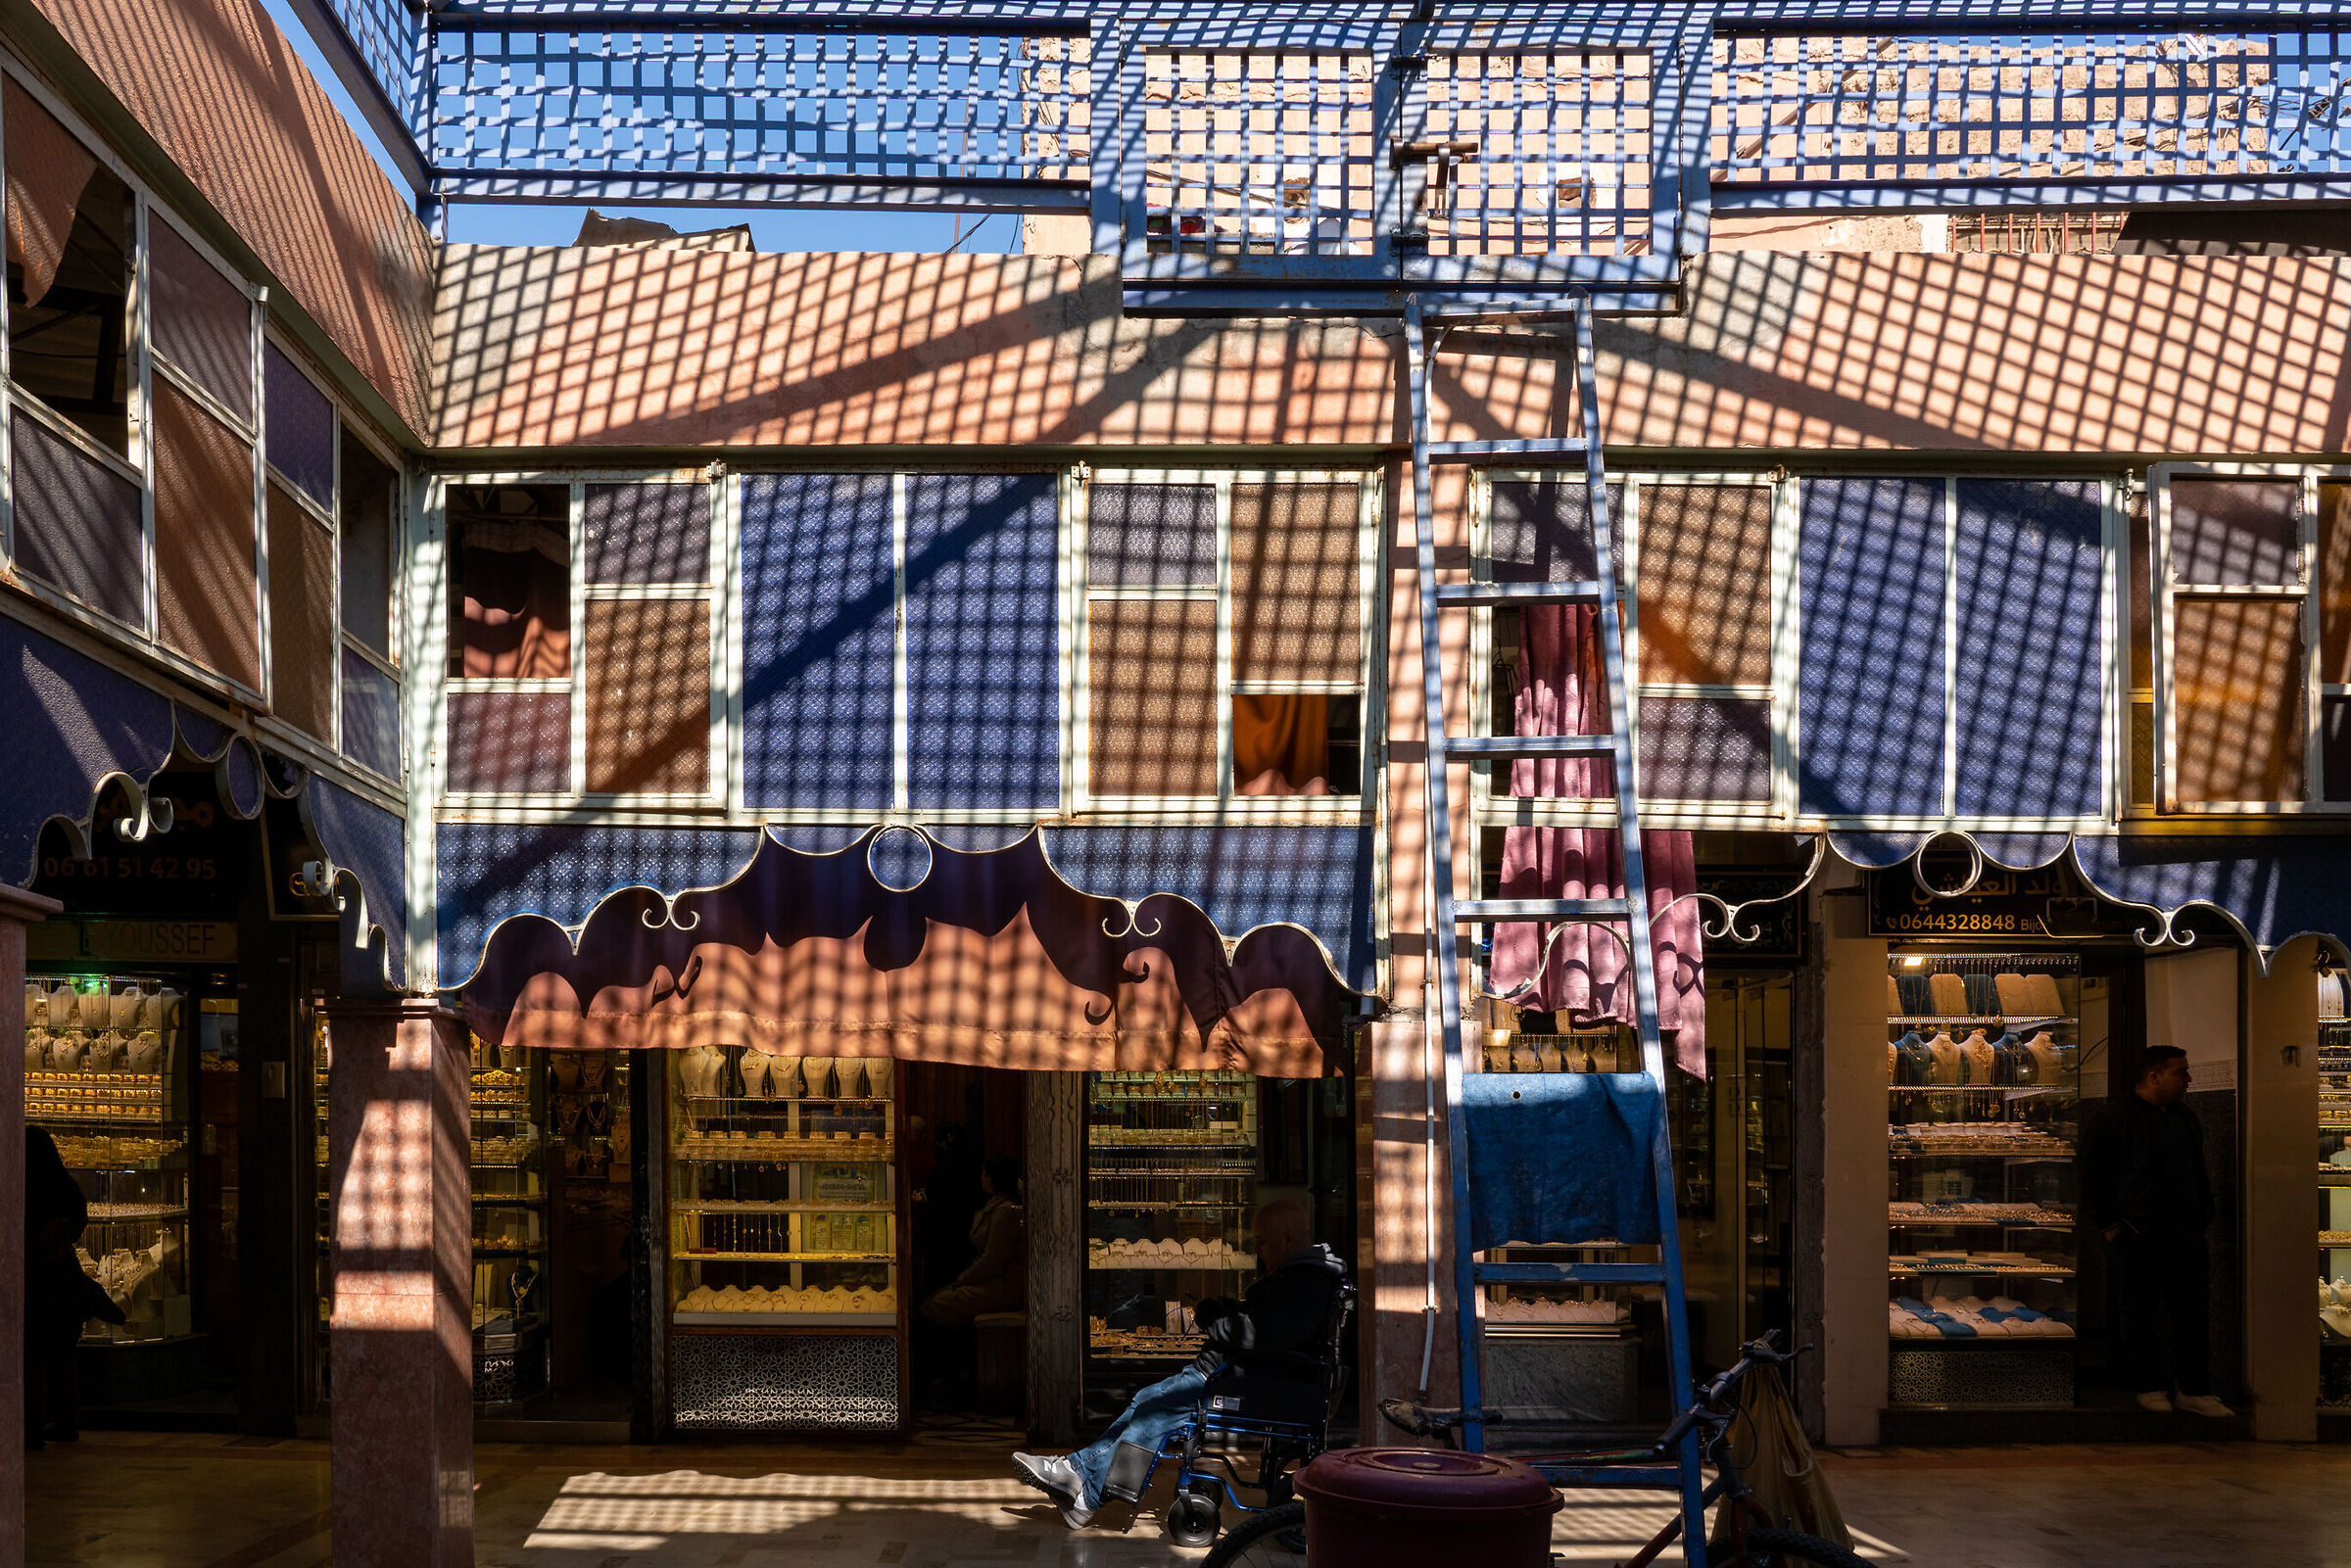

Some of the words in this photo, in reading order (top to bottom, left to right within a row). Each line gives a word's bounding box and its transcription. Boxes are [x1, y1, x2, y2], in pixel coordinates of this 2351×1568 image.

[43, 855, 76, 878] 06
[82, 855, 111, 878] 61
[117, 855, 142, 878] 51
[149, 855, 181, 879] 42
[185, 855, 219, 879] 95
[1899, 914, 2016, 930] 0644328848
[104, 923, 216, 956] YOUSSEF
